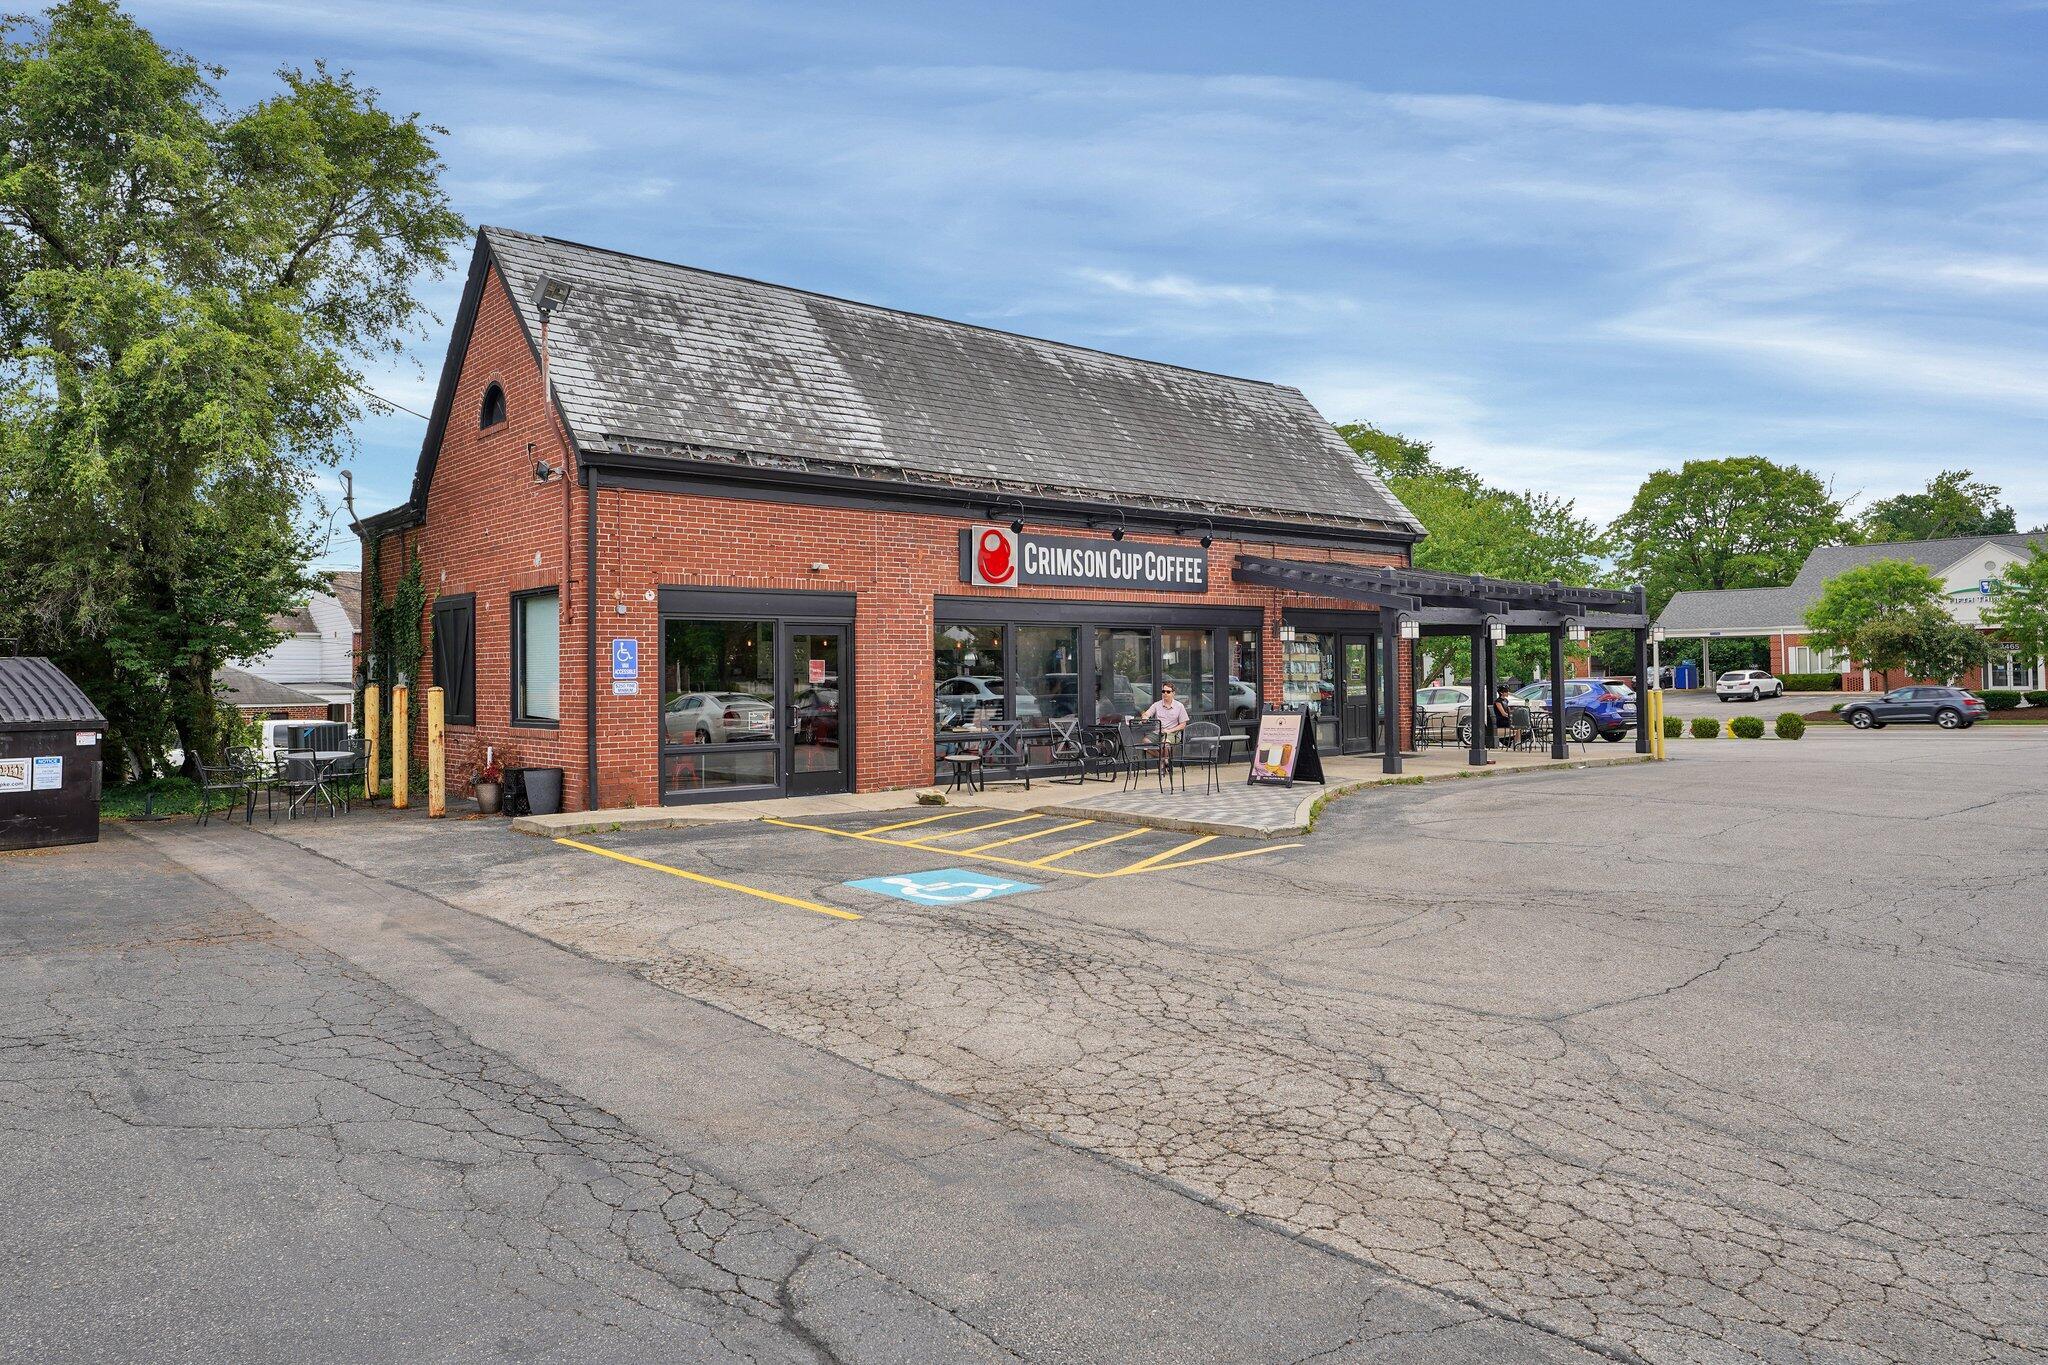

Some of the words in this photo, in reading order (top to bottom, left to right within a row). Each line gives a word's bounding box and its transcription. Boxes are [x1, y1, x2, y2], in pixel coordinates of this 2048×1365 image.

[1024, 542, 1106, 578] CRIMSON
[1109, 548, 1143, 581] CUP
[1145, 551, 1203, 584] COFFEE
